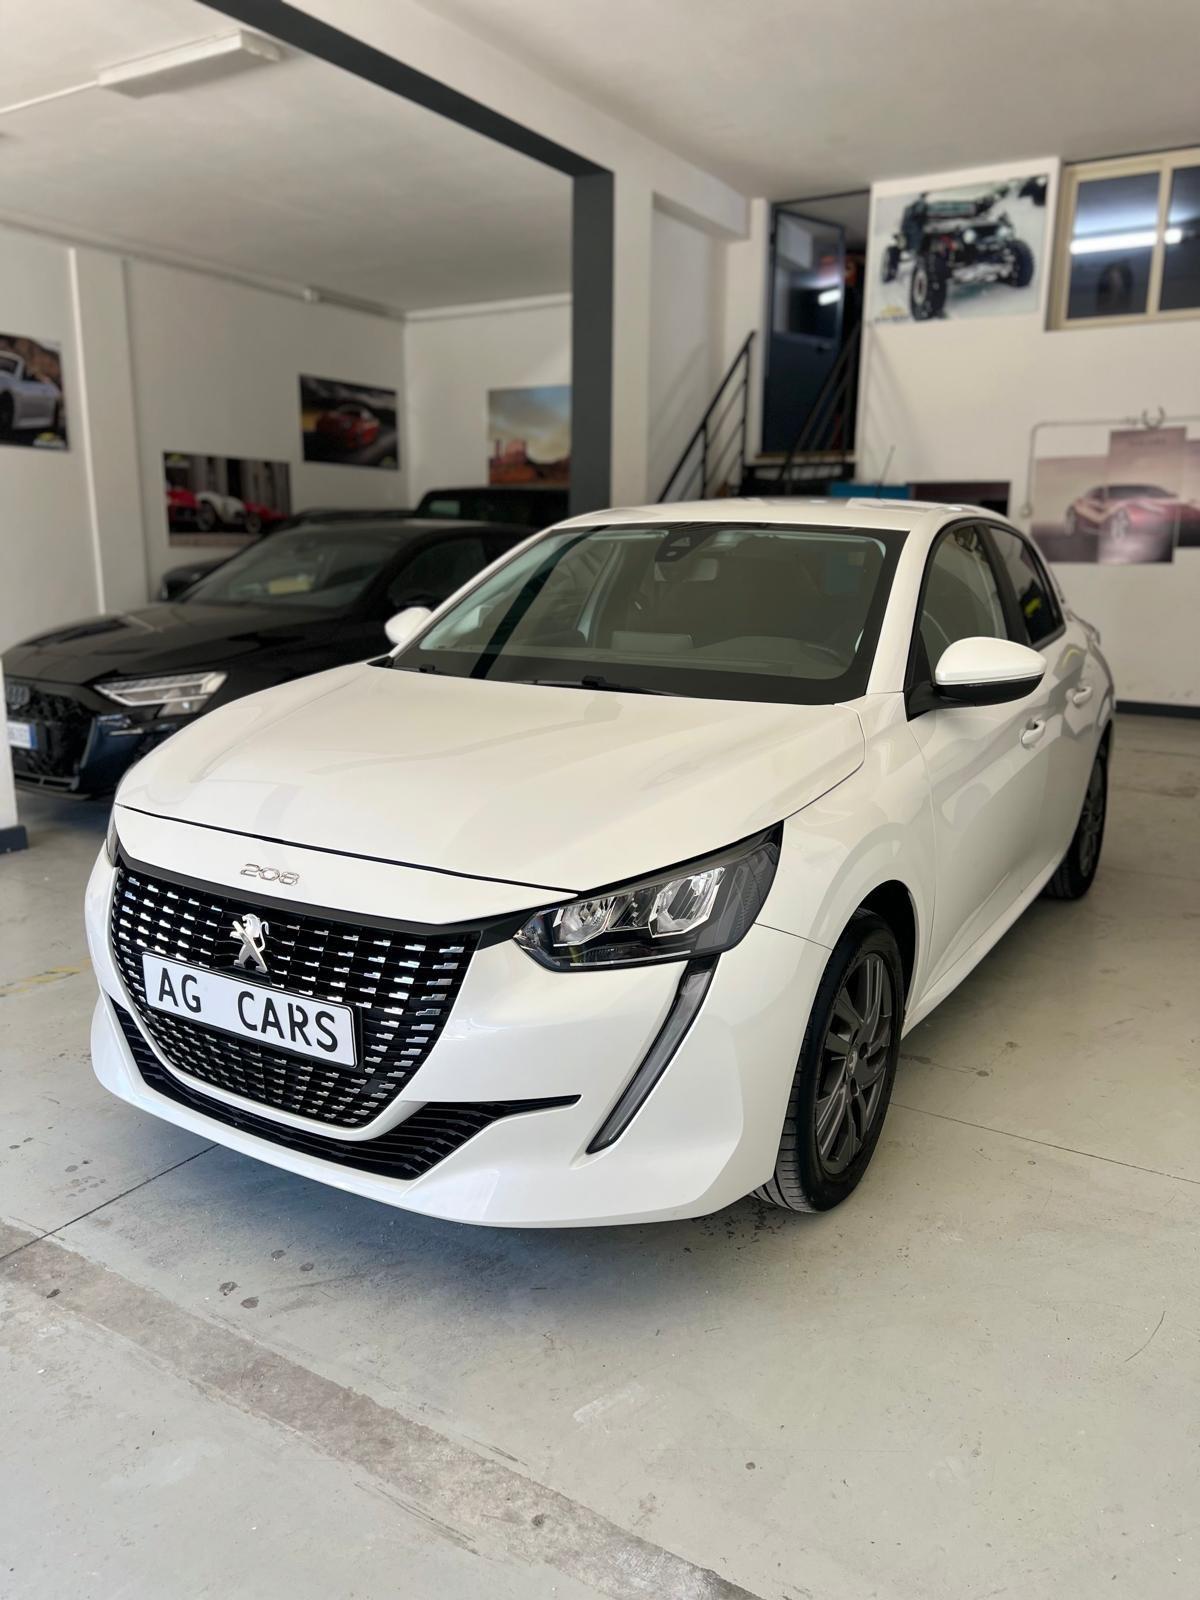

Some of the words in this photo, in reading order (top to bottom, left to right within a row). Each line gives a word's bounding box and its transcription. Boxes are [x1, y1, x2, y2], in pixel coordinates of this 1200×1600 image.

[240, 863, 300, 886] 208
[158, 967, 202, 1013] AG
[237, 991, 338, 1053] CARS
